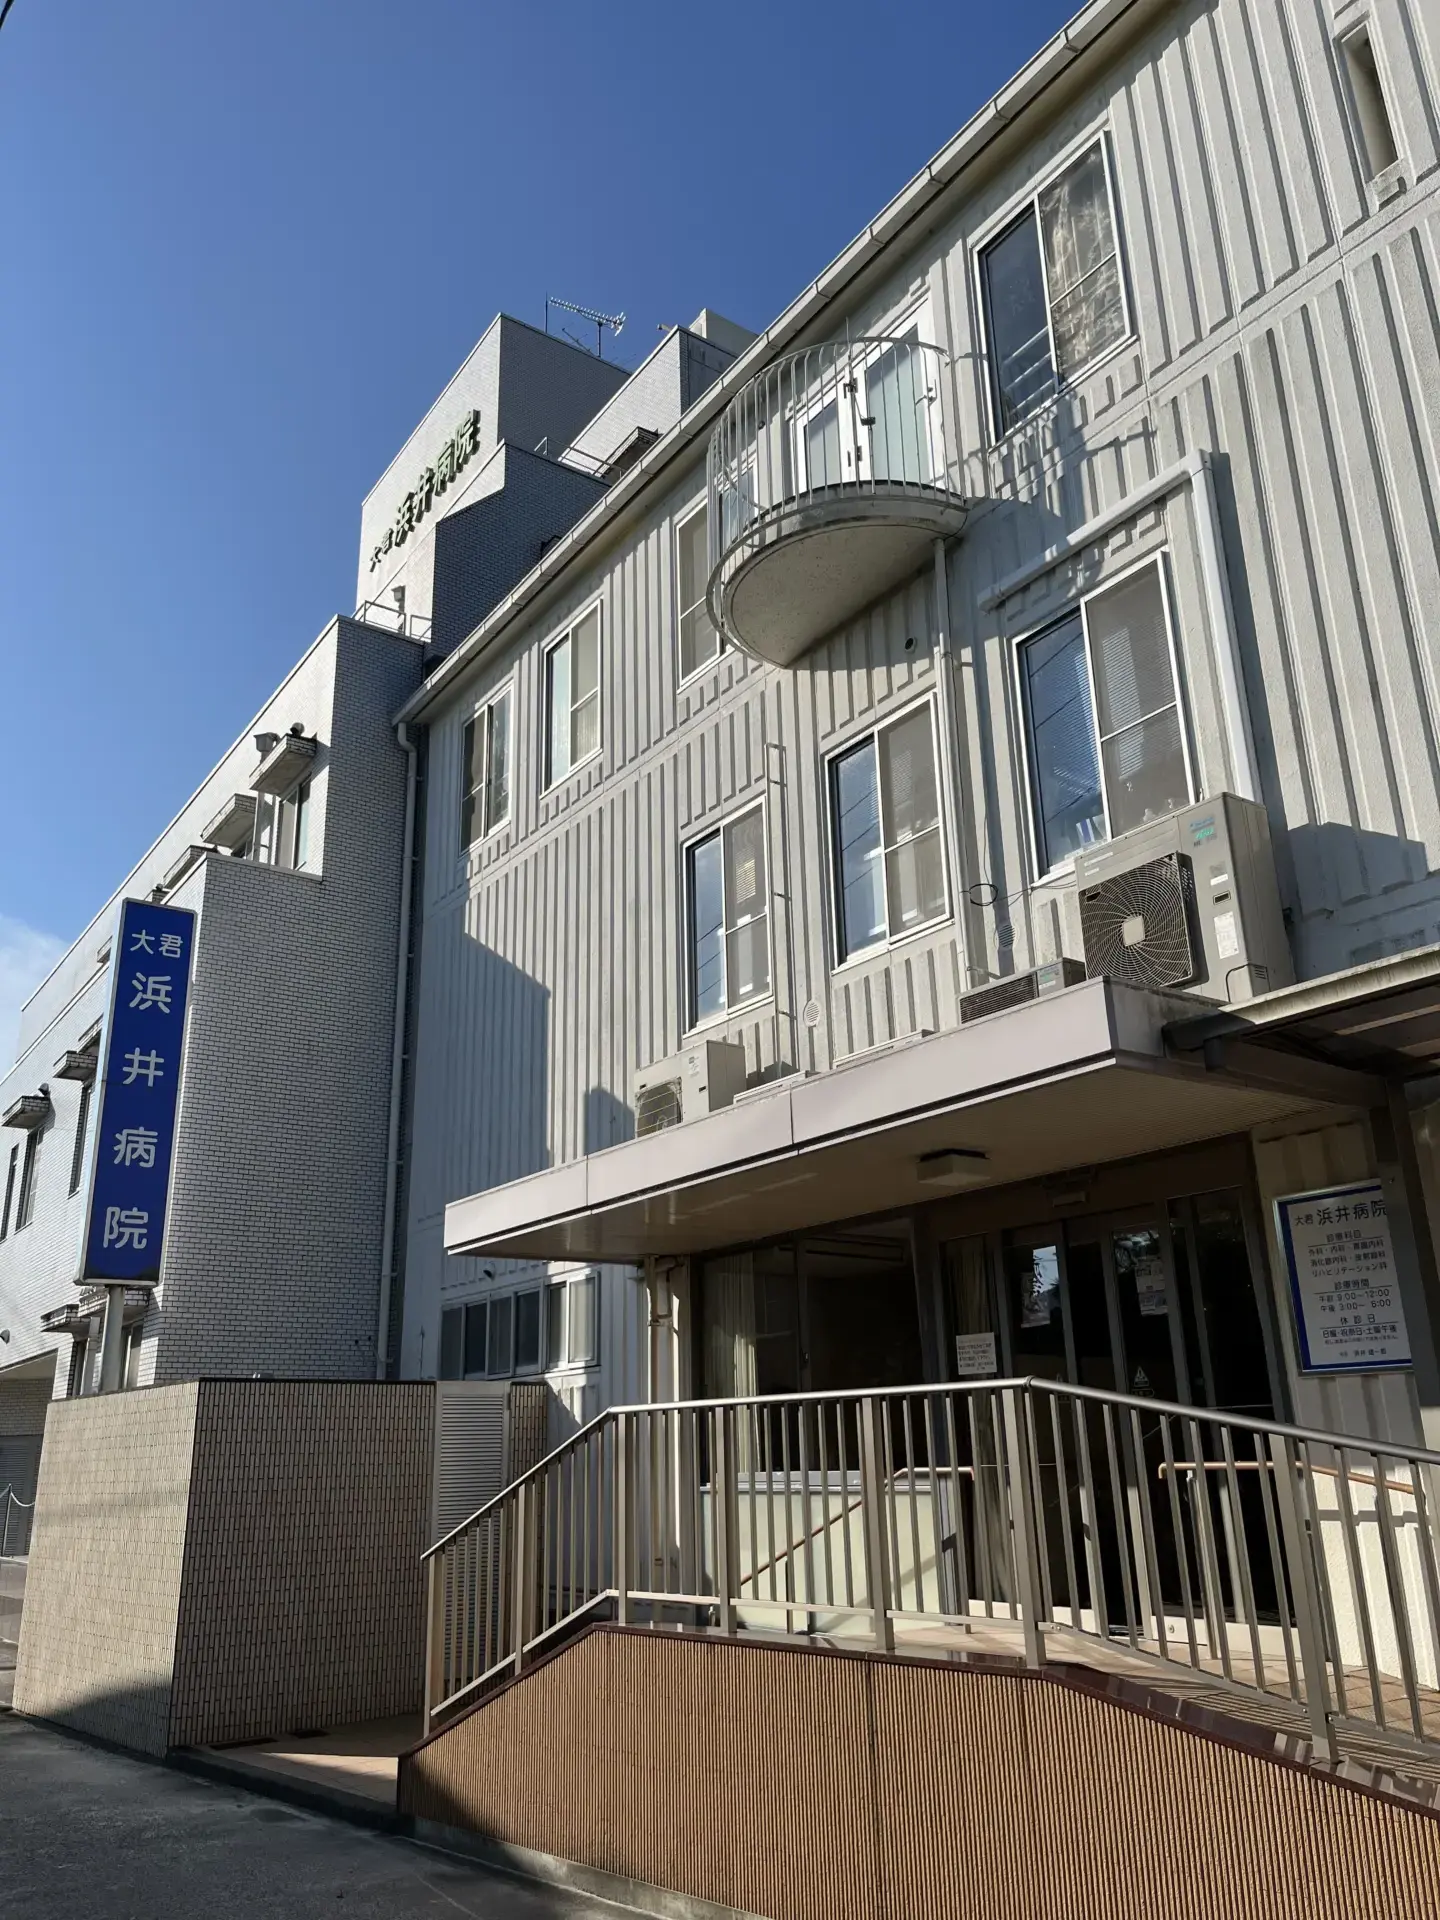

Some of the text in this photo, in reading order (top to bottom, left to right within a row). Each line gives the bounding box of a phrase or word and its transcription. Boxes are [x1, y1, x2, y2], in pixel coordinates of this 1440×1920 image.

[394, 409, 481, 547] 浜井病院
[130, 929, 184, 958] 大君
[103, 971, 172, 1250] 浜井病院
[1295, 1199, 1387, 1226] 大君 浜井病院
